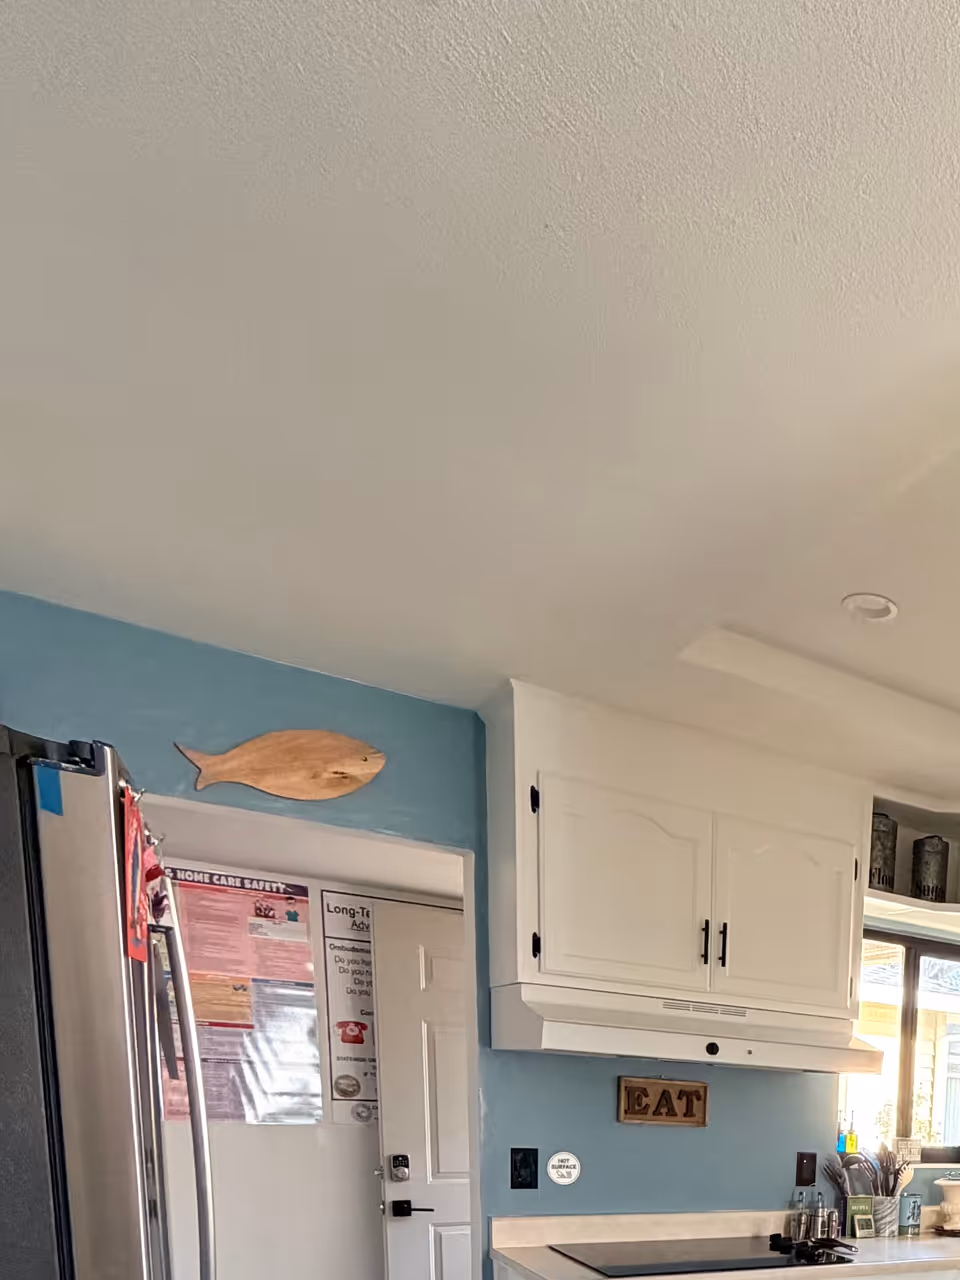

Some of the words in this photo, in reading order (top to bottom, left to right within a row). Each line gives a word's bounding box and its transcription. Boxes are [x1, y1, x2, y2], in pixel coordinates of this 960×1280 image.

[177, 871, 210, 883] HOME
[212, 875, 242, 888] CARE
[243, 879, 285, 893] SAFETY
[624, 1085, 702, 1118] EAT
